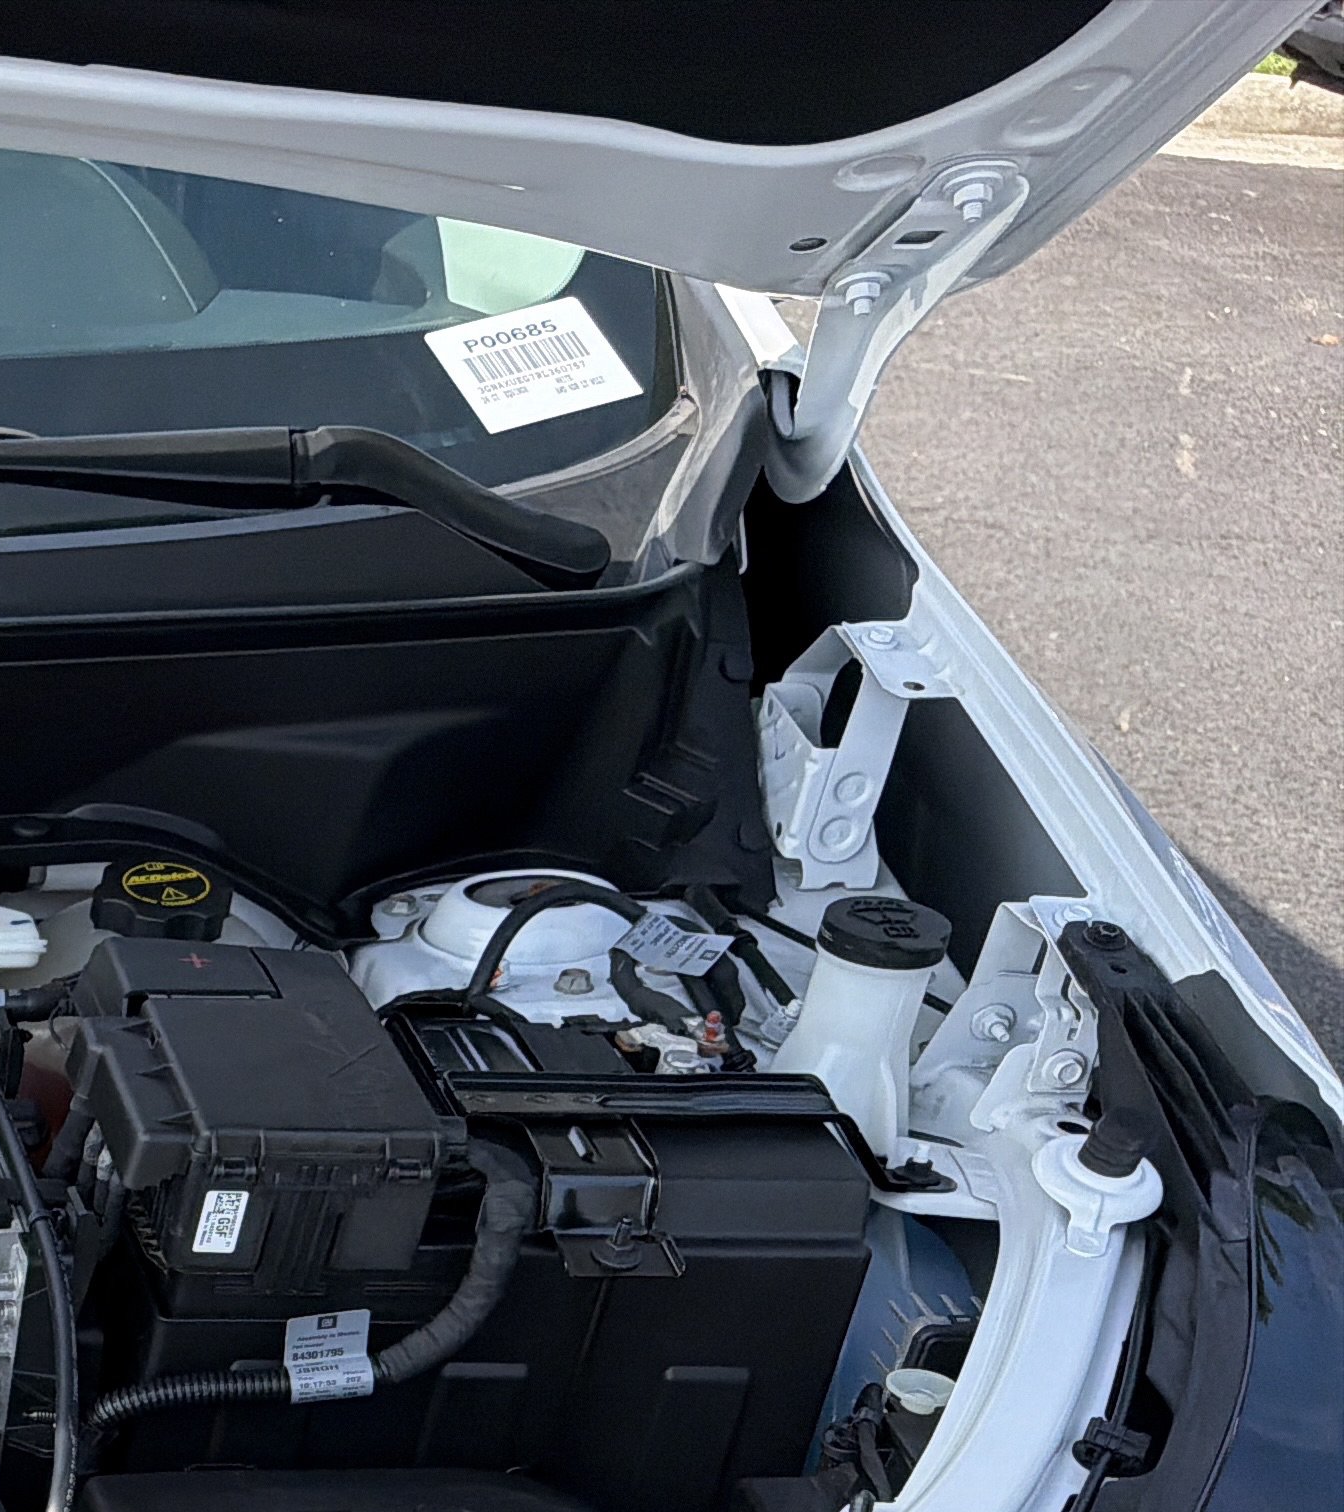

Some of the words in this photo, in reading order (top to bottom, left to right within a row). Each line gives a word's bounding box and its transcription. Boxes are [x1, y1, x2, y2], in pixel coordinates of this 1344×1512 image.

[463, 319, 558, 354] P00685
[214, 1217, 231, 1238] G5F
[292, 1347, 345, 1361] 84301795
